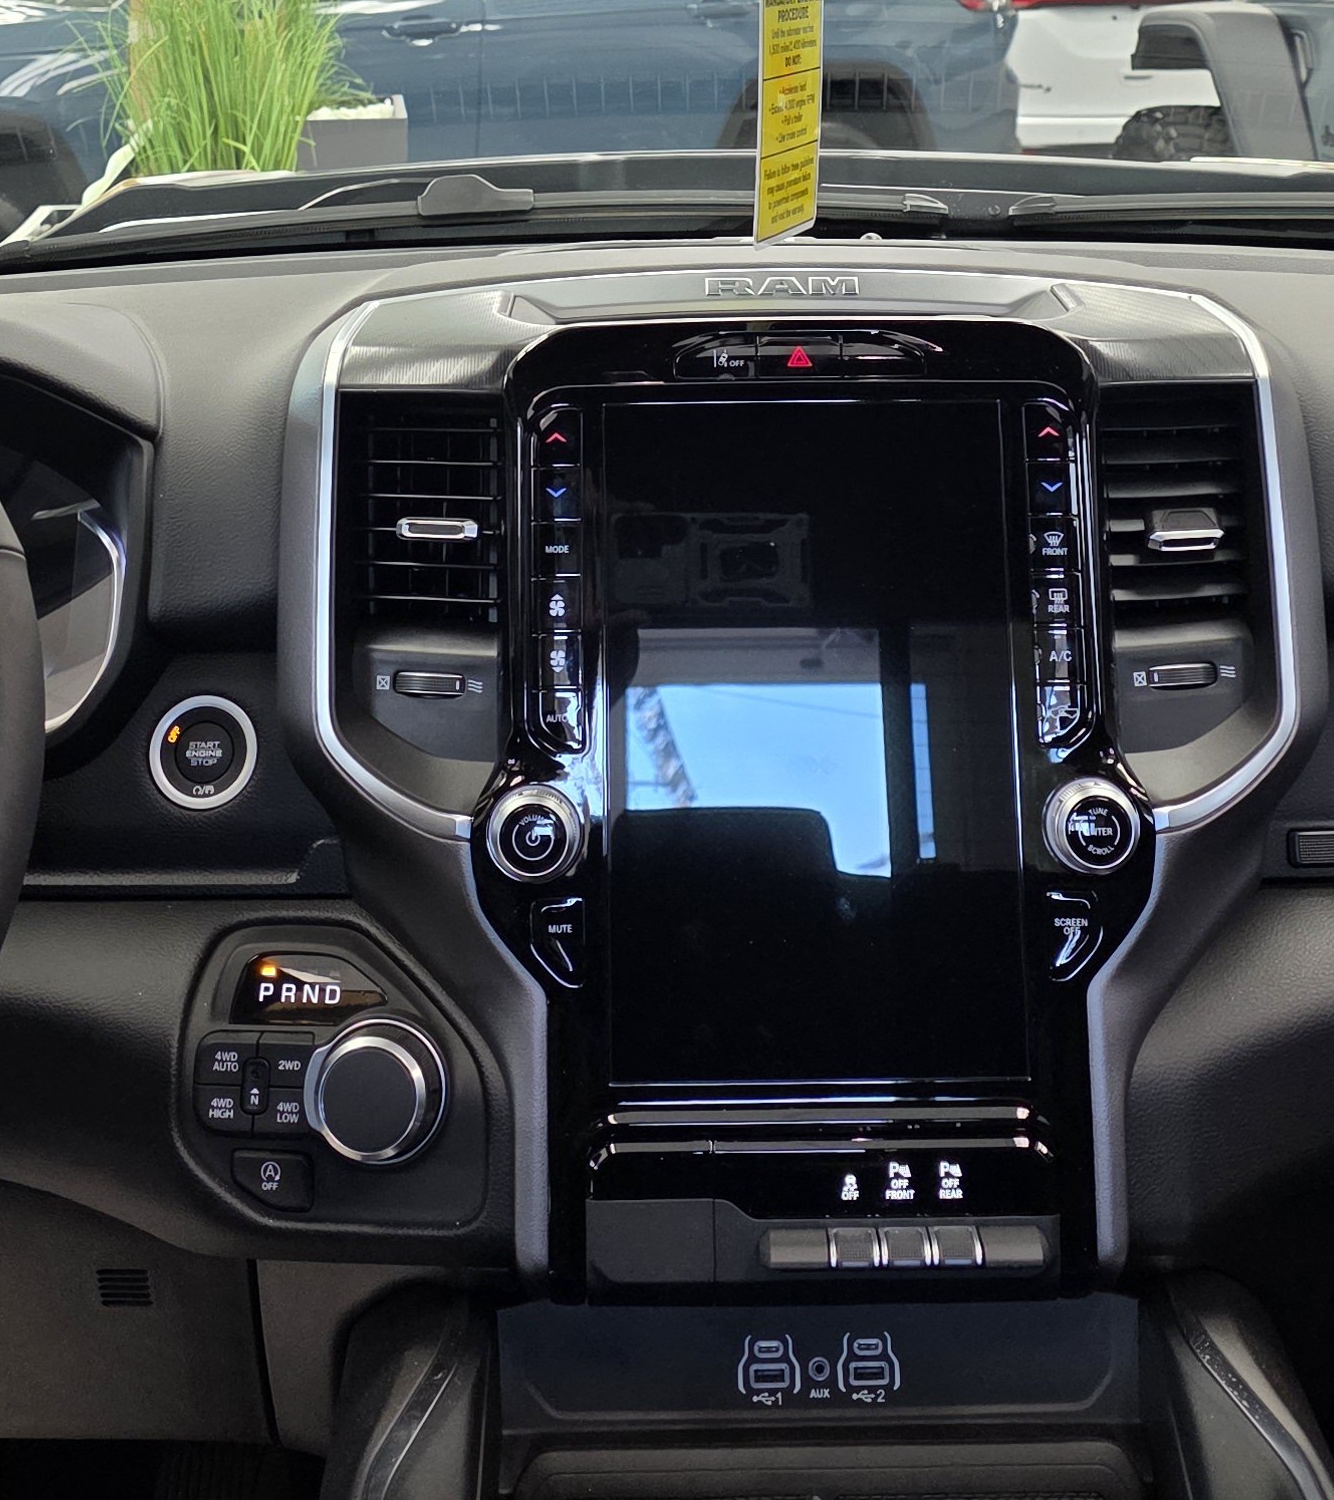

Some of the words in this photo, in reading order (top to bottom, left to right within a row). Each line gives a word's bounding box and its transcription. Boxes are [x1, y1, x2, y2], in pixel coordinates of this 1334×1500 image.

[777, 6, 809, 23] PROCEDURE
[705, 276, 859, 296] RAM
[545, 545, 569, 553] MODE
[1042, 547, 1068, 556] FRONT
[1048, 604, 1070, 613] REAR
[1049, 650, 1072, 662] A/C
[546, 714, 568, 723] AUTO
[189, 741, 220, 750] START
[185, 749, 222, 757] ENGINE
[190, 758, 218, 766] STOP
[1088, 807, 1109, 817] TUNE
[1087, 844, 1115, 856] SCROLL
[1054, 917, 1089, 927] SCREEN
[548, 924, 573, 933] MUTE
[1063, 926, 1081, 936] OFF
[214, 1051, 238, 1062] 4WD
[212, 1062, 239, 1072] AUTO
[278, 1060, 301, 1070] 2WD
[210, 1098, 234, 1108] 4WD
[250, 1095, 259, 1105] N
[276, 1102, 300, 1112] 4WD
[208, 1109, 234, 1119] HIGH
[276, 1112, 300, 1123] LOW
[261, 1182, 279, 1190] OFF
[891, 1179, 909, 1189] OFF
[941, 1178, 960, 1189] OFF
[841, 1190, 860, 1201] OFF
[885, 1189, 915, 1200] FRONT
[938, 1189, 963, 1200] REAR
[776, 1391, 783, 1406] 1
[809, 1388, 830, 1399] AUX
[876, 1389, 886, 1403] 2
